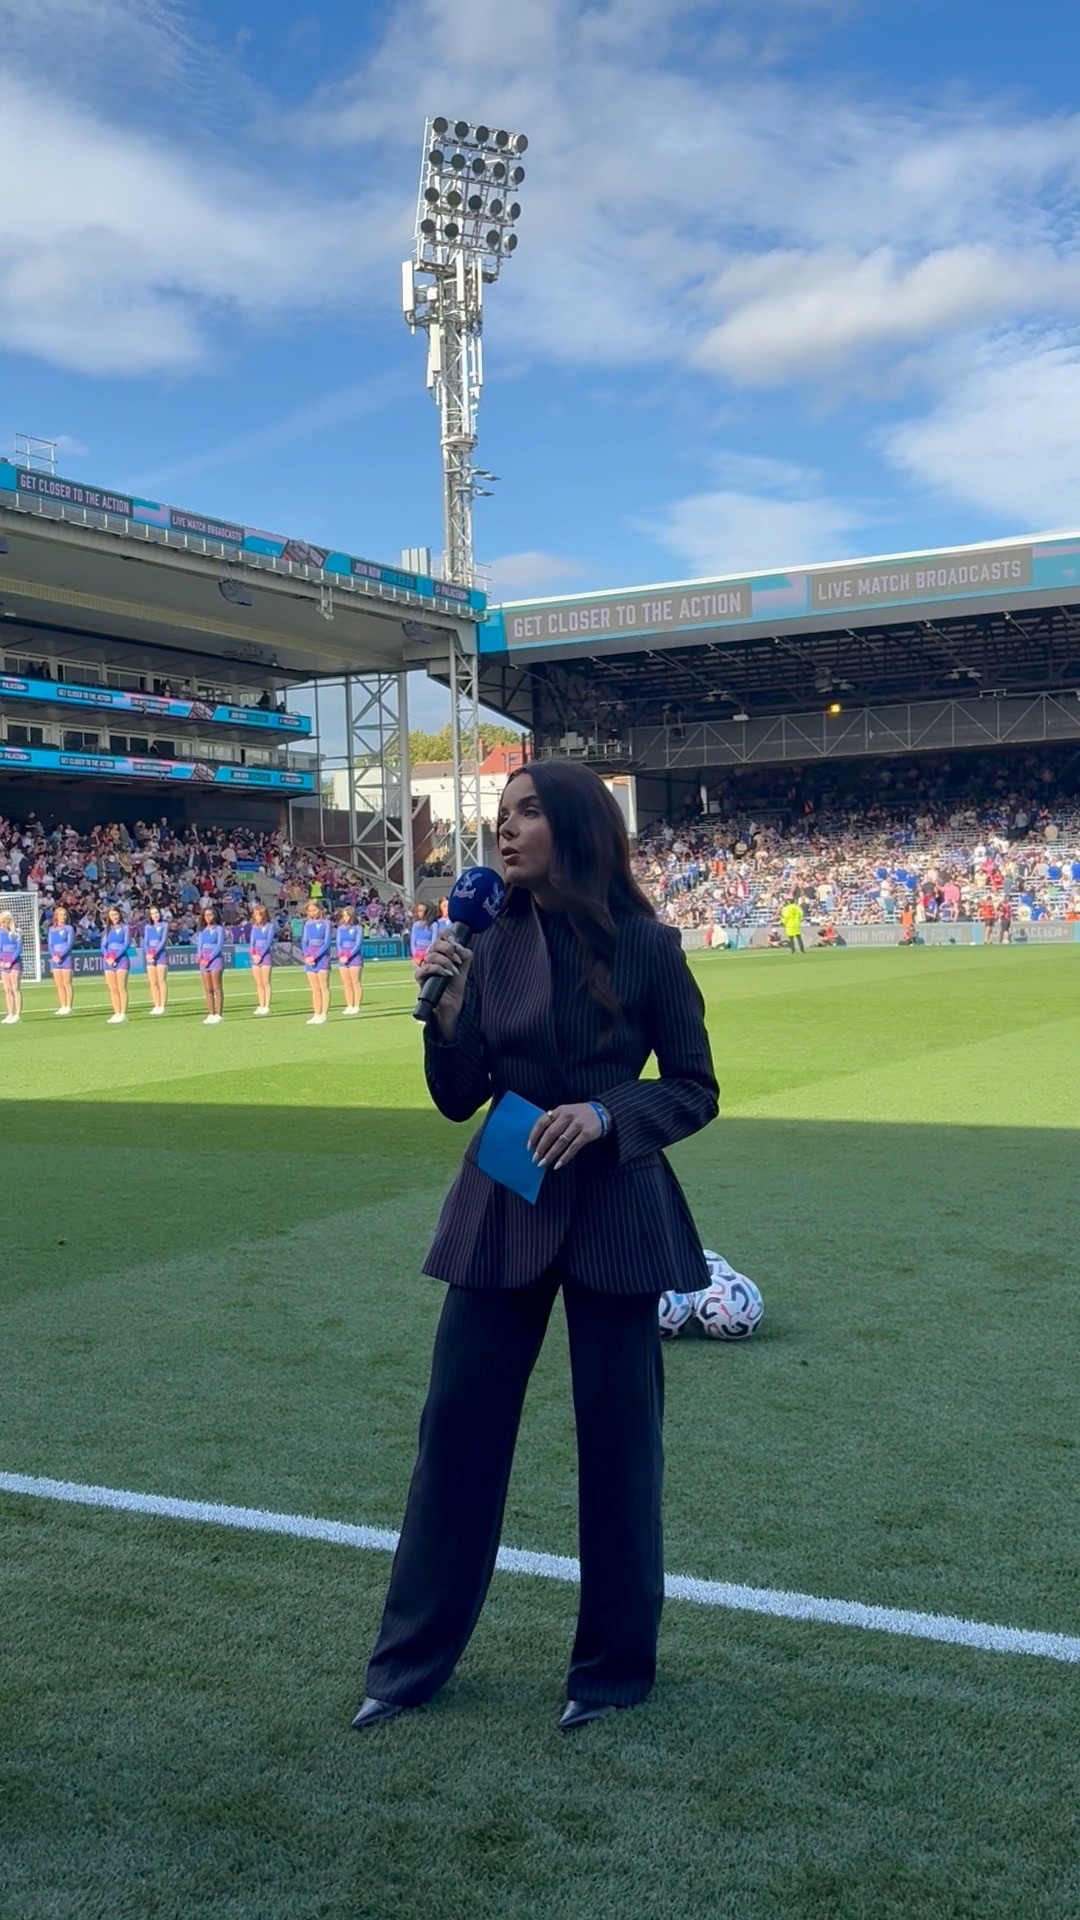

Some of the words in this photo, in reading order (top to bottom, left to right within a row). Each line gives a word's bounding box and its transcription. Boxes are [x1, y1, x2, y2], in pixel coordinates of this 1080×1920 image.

[20, 474, 36, 490] GET
[39, 479, 71, 499] CLOSER
[73, 488, 83, 502] TO
[85, 491, 100, 506] THE
[101, 496, 130, 514] ACTION
[172, 515, 186, 527] LIVE
[187, 519, 206, 532] MATCH
[207, 524, 242, 541] BROADCASTS
[818, 580, 852, 600] LIVE
[858, 574, 909, 596] MATCH
[916, 560, 1021, 589] BROADCASTS
[514, 615, 543, 638] GET
[549, 607, 611, 635] CLOSER
[616, 604, 635, 626] TO
[642, 600, 673, 624] THE
[679, 592, 742, 619] ACTION
[847, 930, 868, 942] JOIN
[871, 929, 895, 941] NOW
[83, 957, 104, 972] ACTI
